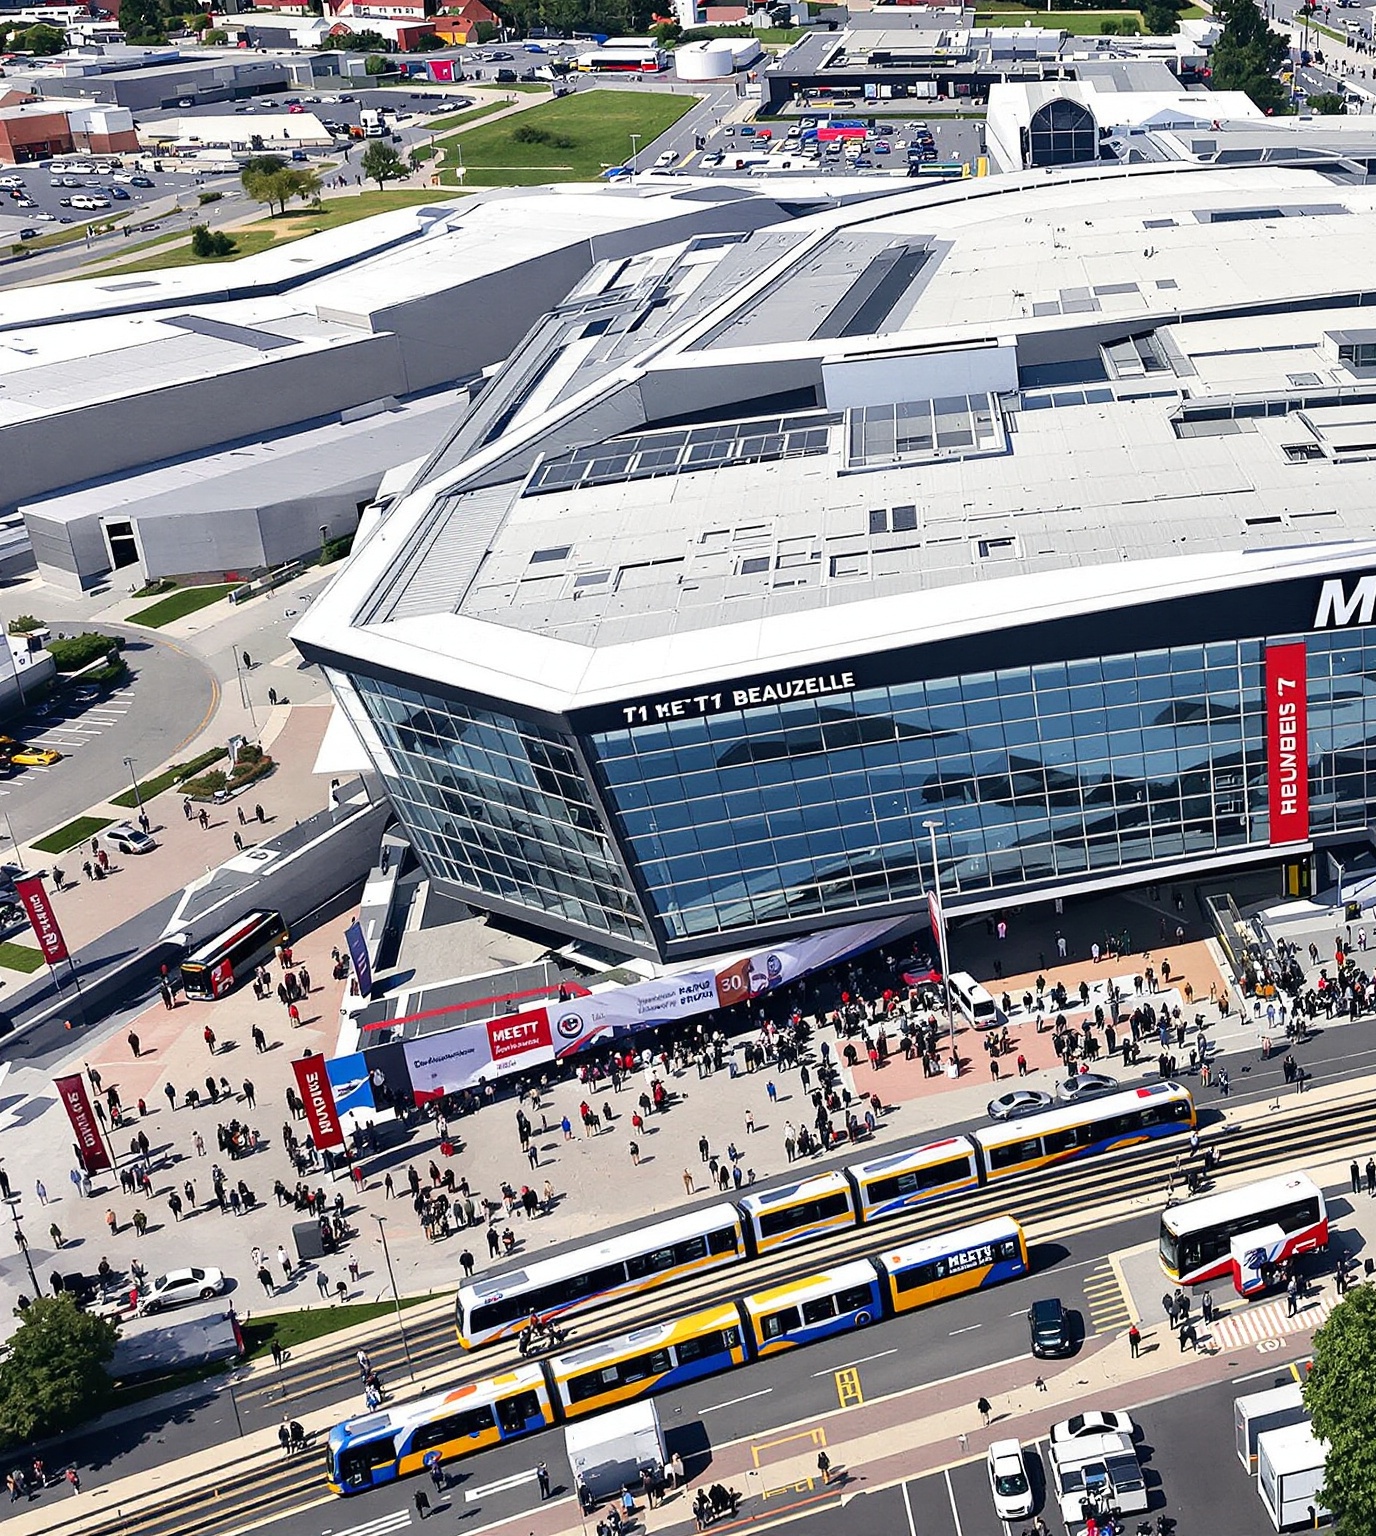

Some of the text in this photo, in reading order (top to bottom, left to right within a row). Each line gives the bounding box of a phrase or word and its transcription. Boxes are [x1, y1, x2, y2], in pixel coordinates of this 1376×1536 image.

[732, 672, 855, 706] BEAUZELLE
[720, 974, 742, 993] 30
[492, 1020, 539, 1043] MEETT
